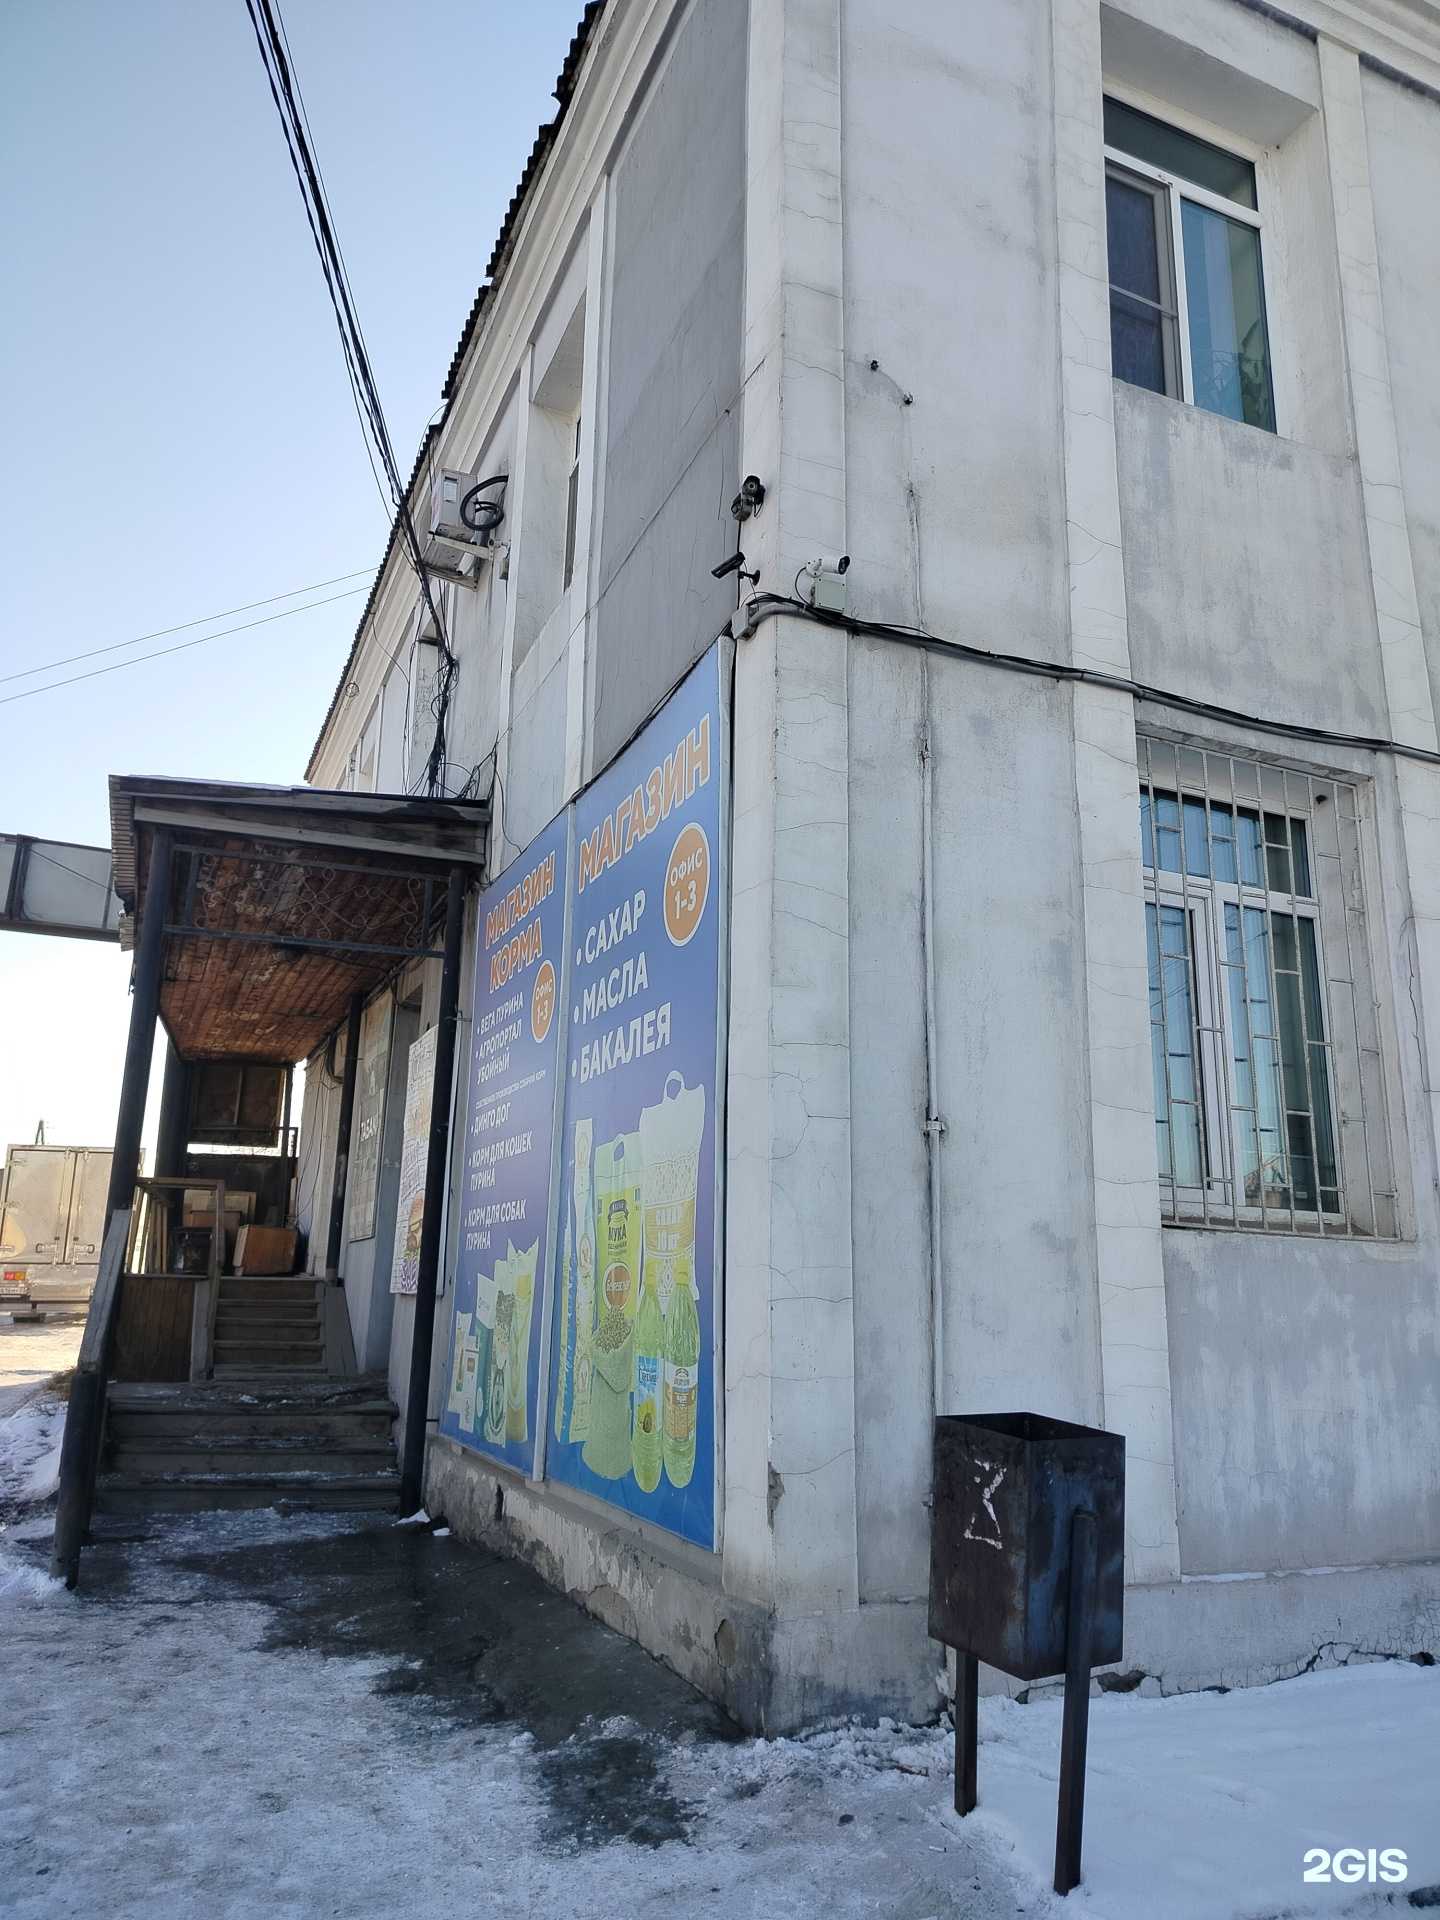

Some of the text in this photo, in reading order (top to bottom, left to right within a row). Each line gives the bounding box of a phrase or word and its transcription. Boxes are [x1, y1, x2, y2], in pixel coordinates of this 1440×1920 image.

[578, 712, 711, 896] МАГАЗИН
[670, 847, 703, 888] ОФИС
[485, 848, 556, 950] МАГАЗИН
[674, 880, 697, 919] 1-3
[584, 889, 646, 964] САХАР
[489, 916, 543, 994] КОРМА
[535, 979, 553, 1000] ОФИС
[582, 951, 649, 1025] МАСЛА
[480, 991, 524, 1035] ВЕГА ПУРИНА
[537, 1000, 548, 1024] 1-3
[580, 1002, 671, 1084] БАКАЛЕЯ
[494, 1102, 511, 1129] ДОГ
[471, 1131, 533, 1169] КОРМ ДЛЯ КОШЕК
[470, 1168, 496, 1191] ПУРИНА
[467, 1199, 527, 1228] КОРМ ДЛЯ СОБАК
[466, 1230, 491, 1251] ПУРИНА
